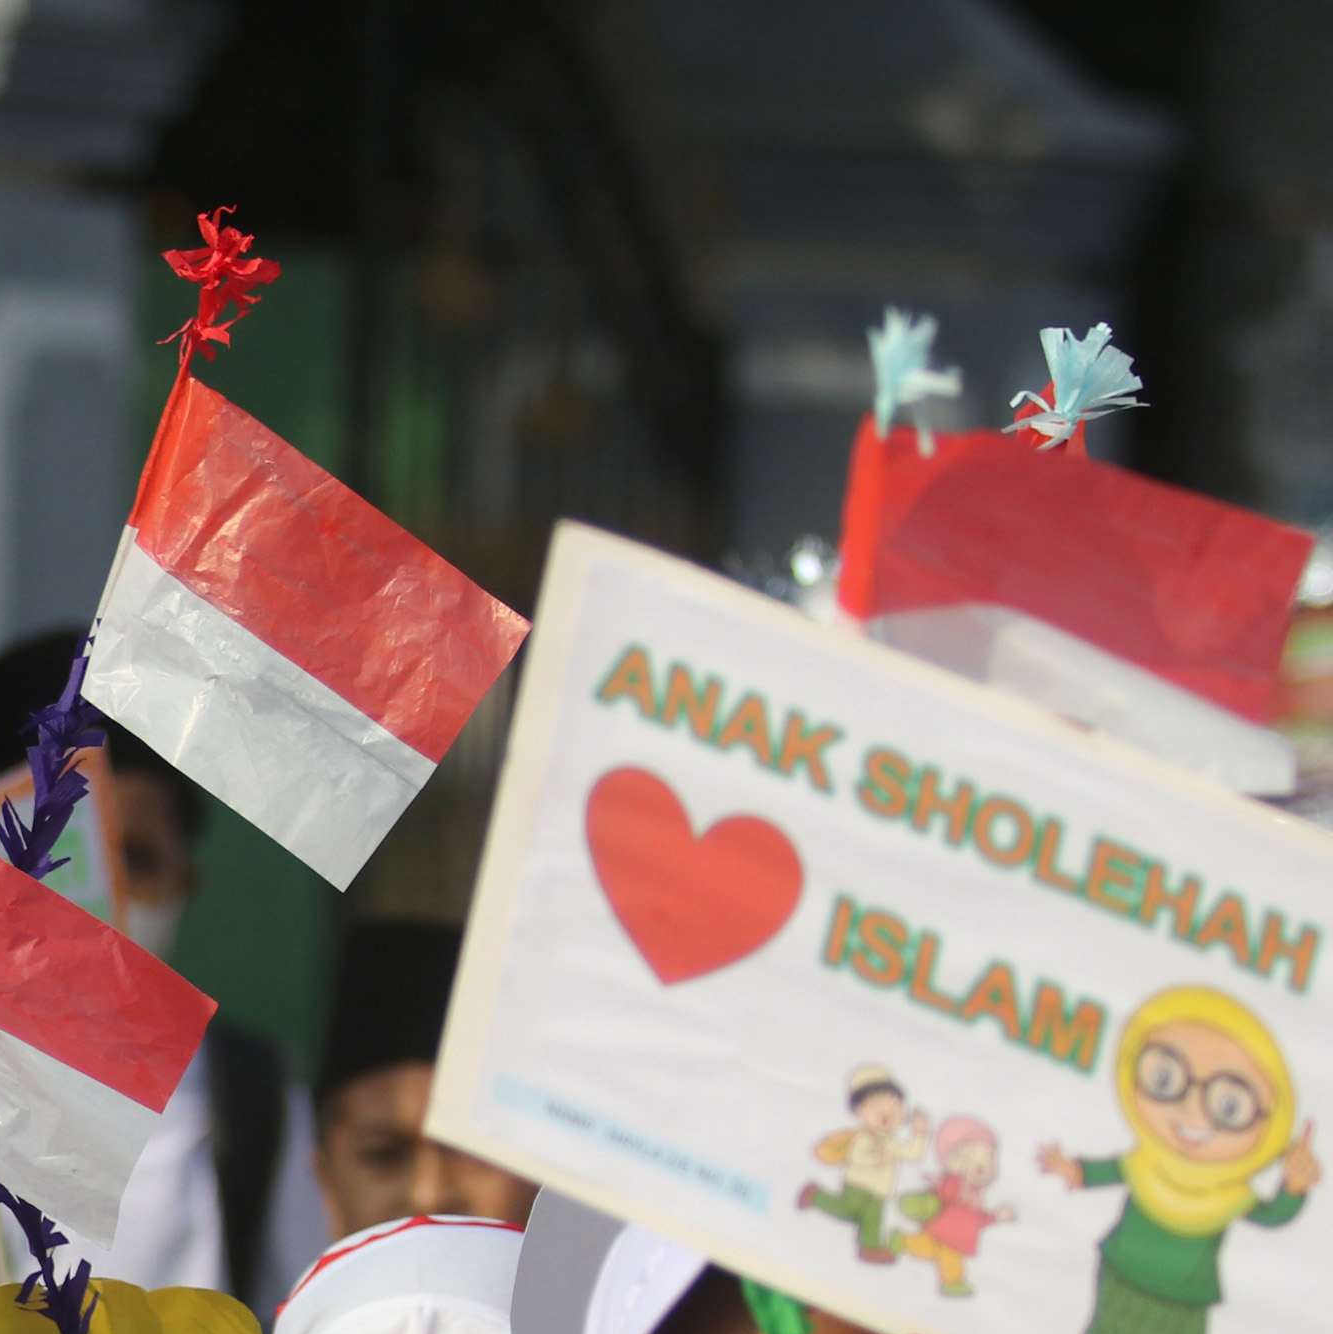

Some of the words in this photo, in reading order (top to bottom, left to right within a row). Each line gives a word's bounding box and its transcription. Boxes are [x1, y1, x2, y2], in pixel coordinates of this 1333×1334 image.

[594, 642, 846, 795] ANAK
[853, 744, 1325, 997] SHOLEHAH
[819, 892, 1110, 1077] ISLAM
